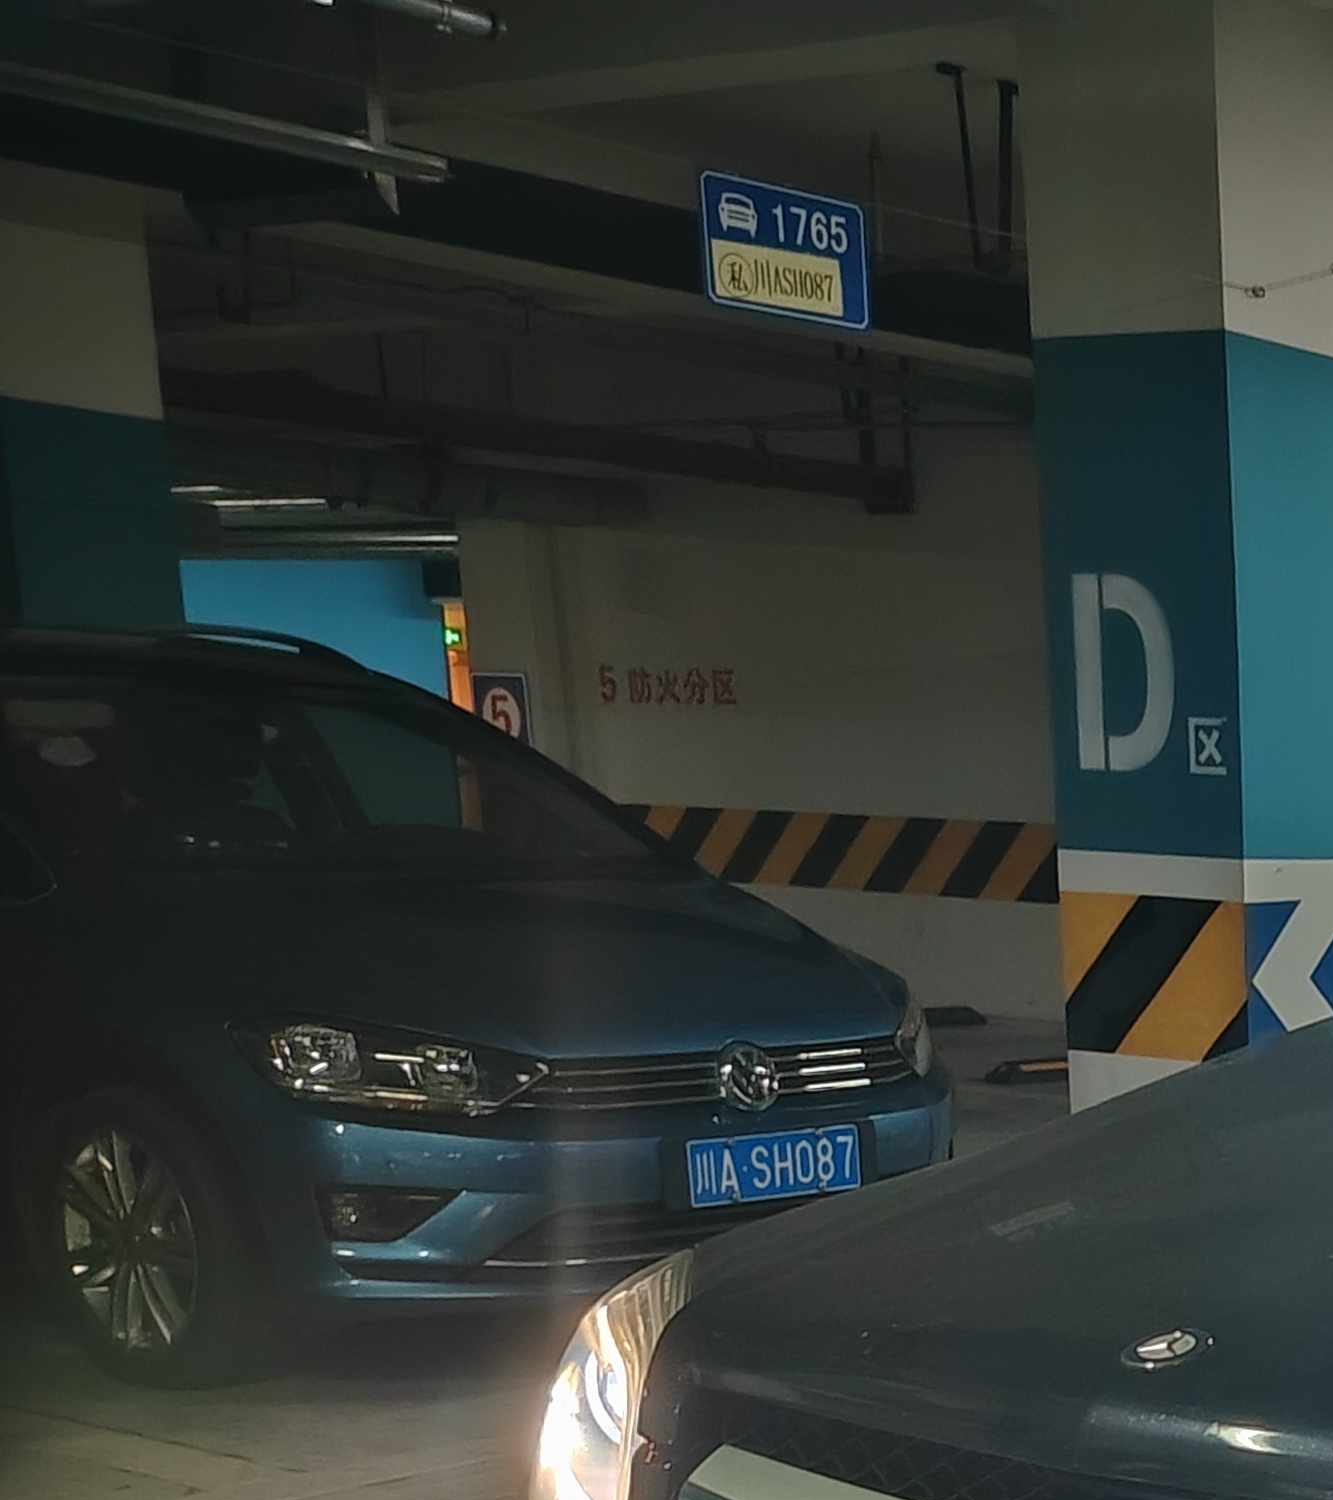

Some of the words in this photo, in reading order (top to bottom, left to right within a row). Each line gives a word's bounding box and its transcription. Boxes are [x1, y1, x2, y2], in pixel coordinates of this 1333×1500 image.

[771, 202, 848, 254] 1765
[599, 664, 616, 703] 5
[628, 666, 738, 705] 防火分区
[1071, 572, 1176, 772] D
[1187, 716, 1228, 776] 区
